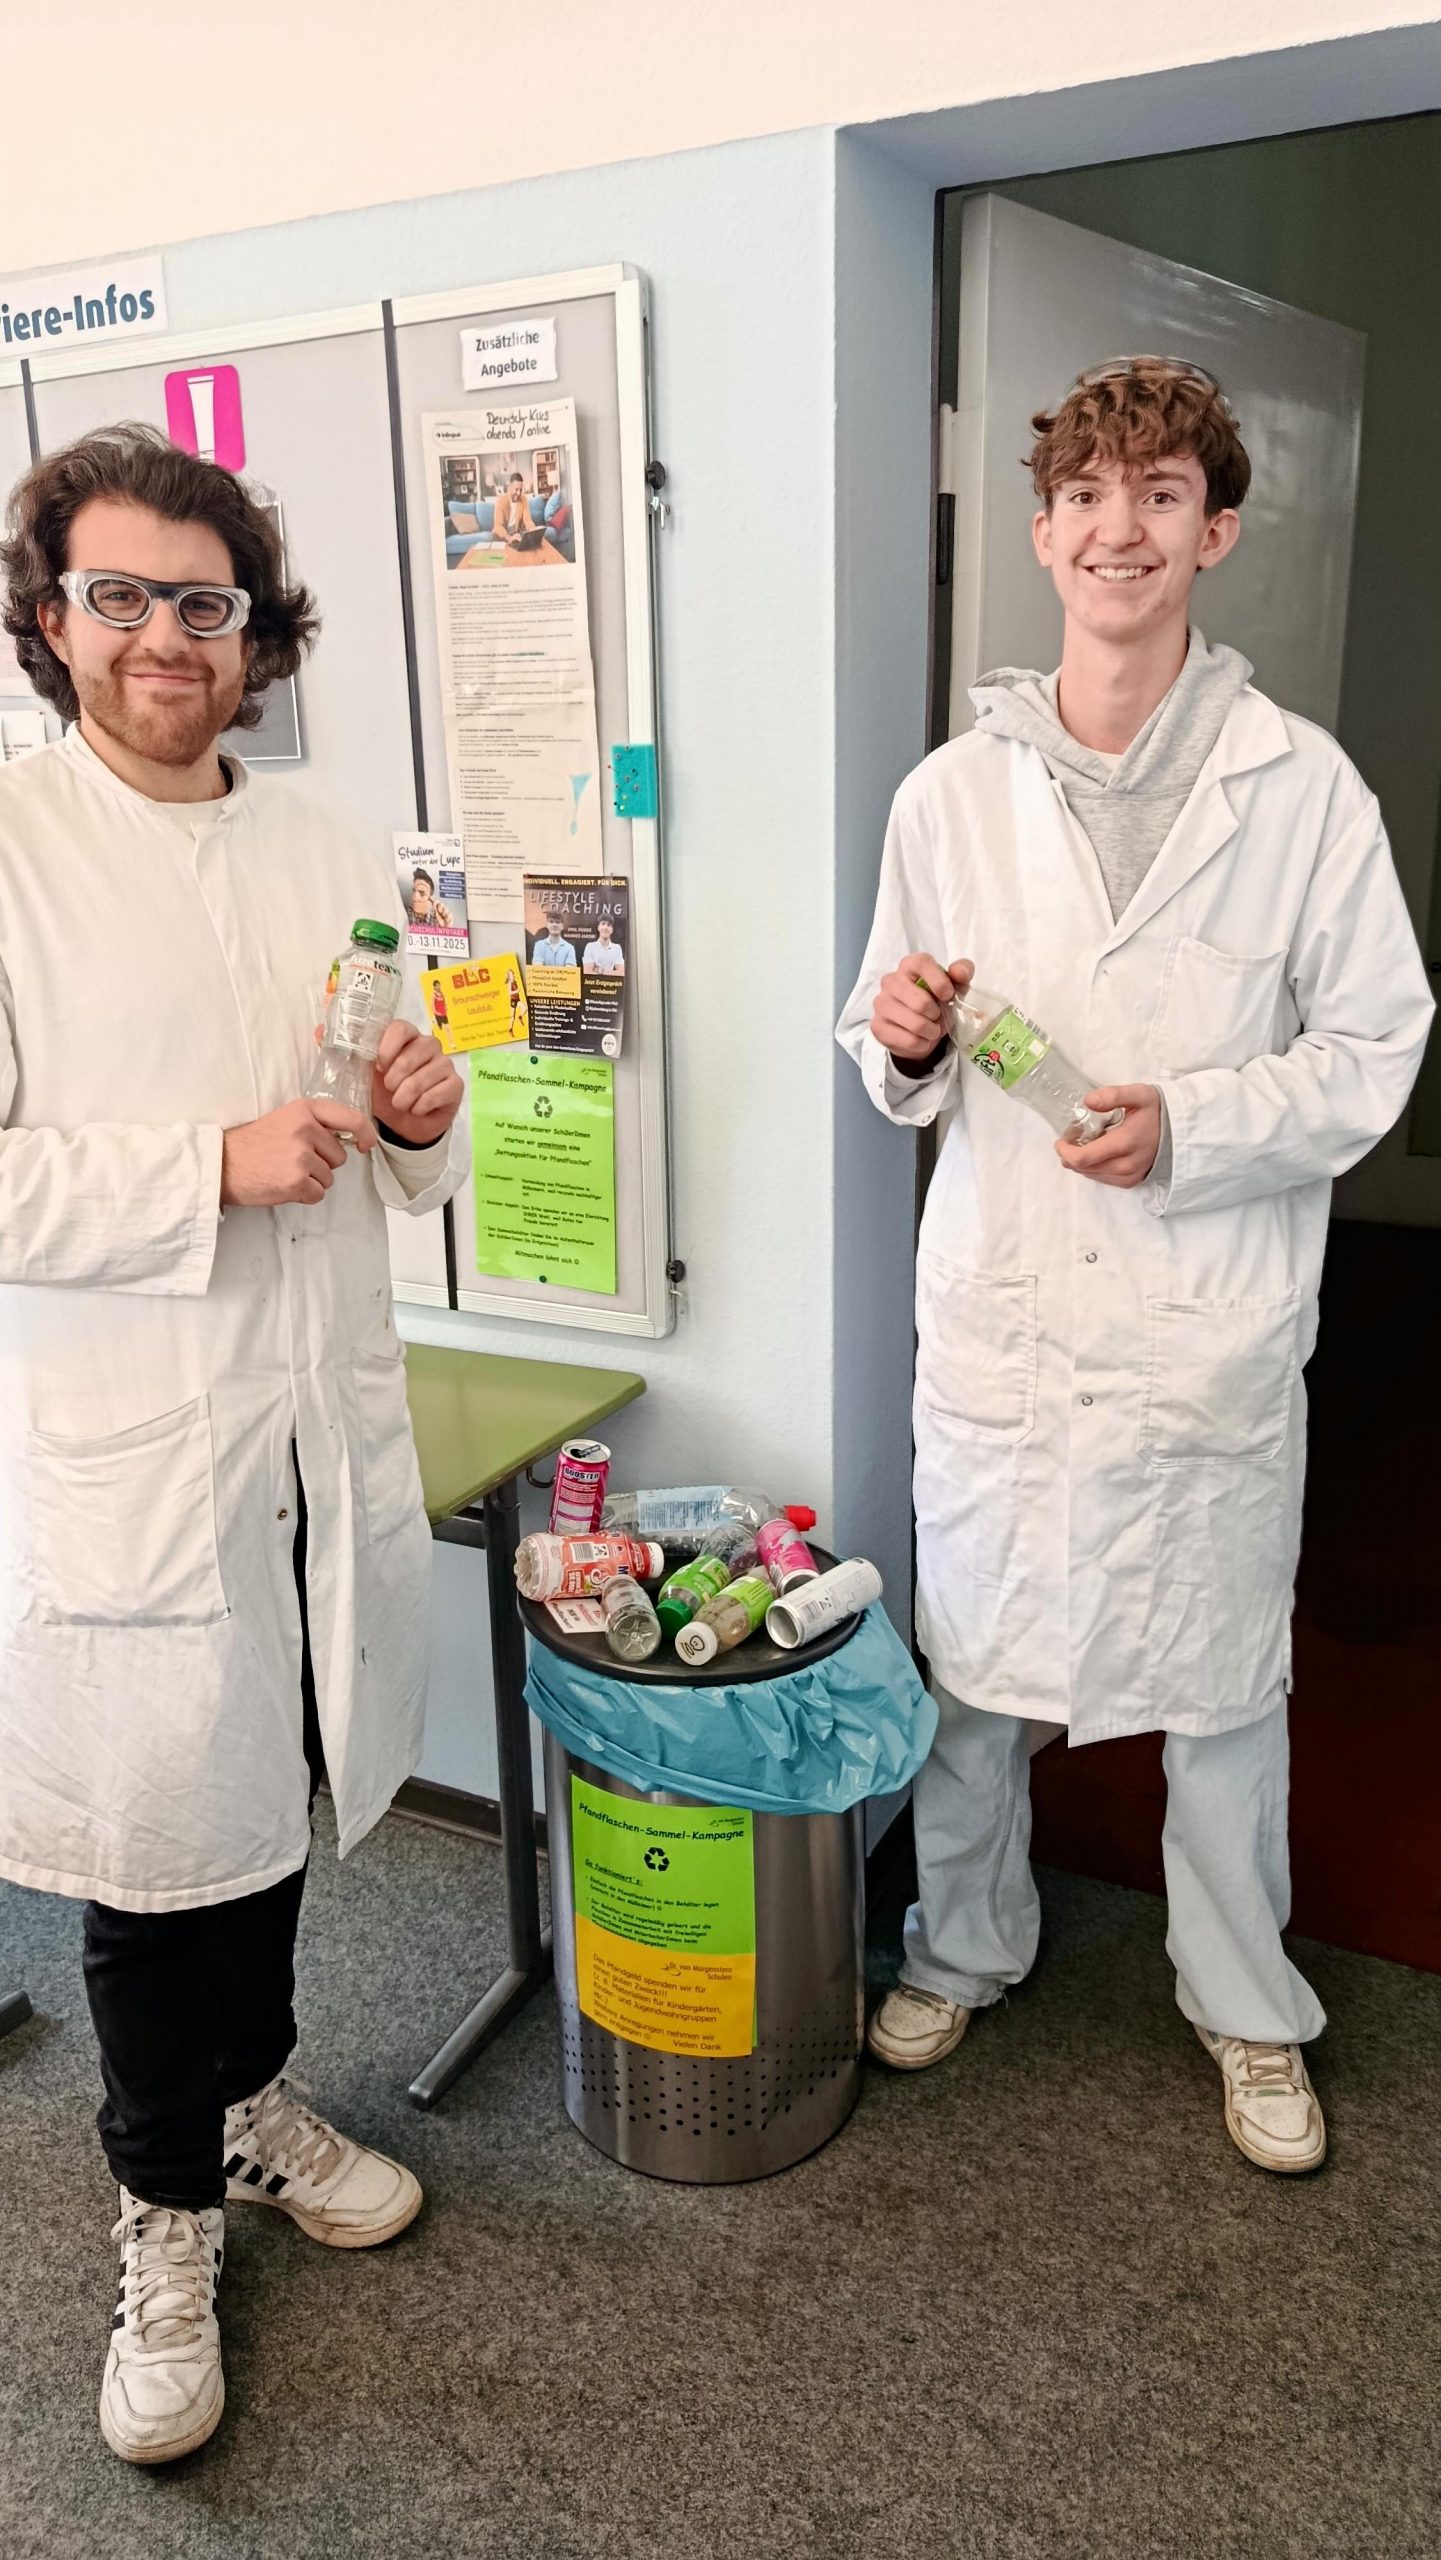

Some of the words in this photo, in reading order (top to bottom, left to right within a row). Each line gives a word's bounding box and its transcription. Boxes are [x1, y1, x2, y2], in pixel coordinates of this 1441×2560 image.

[0, 284, 155, 343] iere-Infos
[475, 331, 540, 352] Zusätzliche
[481, 358, 538, 378] Angebote
[486, 426, 516, 440] abends
[526, 424, 552, 438] online
[398, 846, 434, 860] Studium
[440, 853, 461, 868] Lupe
[530, 891, 595, 904] LIFESTYLE
[541, 902, 623, 915] COACHING
[408, 935, 466, 950] 0.-13.11.2025
[477, 1069, 608, 1094] Pfandflaschen-Sammel-Kampagne
[506, 1122, 528, 1132] Wunsch
[529, 1126, 552, 1134] unserer
[553, 1128, 591, 1139] SchülerInnen
[537, 1142, 568, 1151] gemeinsam
[564, 1466, 600, 1482] BOOSTER
[578, 1802, 745, 1843] Pfandflaschen-Sammel-Kampagne
[693, 1964, 733, 1974] Morgenstern
[606, 1961, 642, 1982] Pfandgeld
[643, 1977, 678, 1991] spenden
[680, 1984, 693, 1993] wir
[694, 1985, 707, 1994] für
[612, 1974, 633, 1989] guten
[612, 1981, 651, 2004] Materialien
[653, 1998, 664, 2007] für
[667, 2000, 722, 2015] Kindergärten,
[618, 1995, 632, 2007] und
[634, 2001, 717, 2024] Jugendwohngruppen
[619, 2014, 665, 2036] Anregungen
[666, 2029, 700, 2041] nehmen
[702, 2033, 715, 2042] wir
[672, 2039, 698, 2051] Vielen
[700, 2041, 722, 2051] Dank
